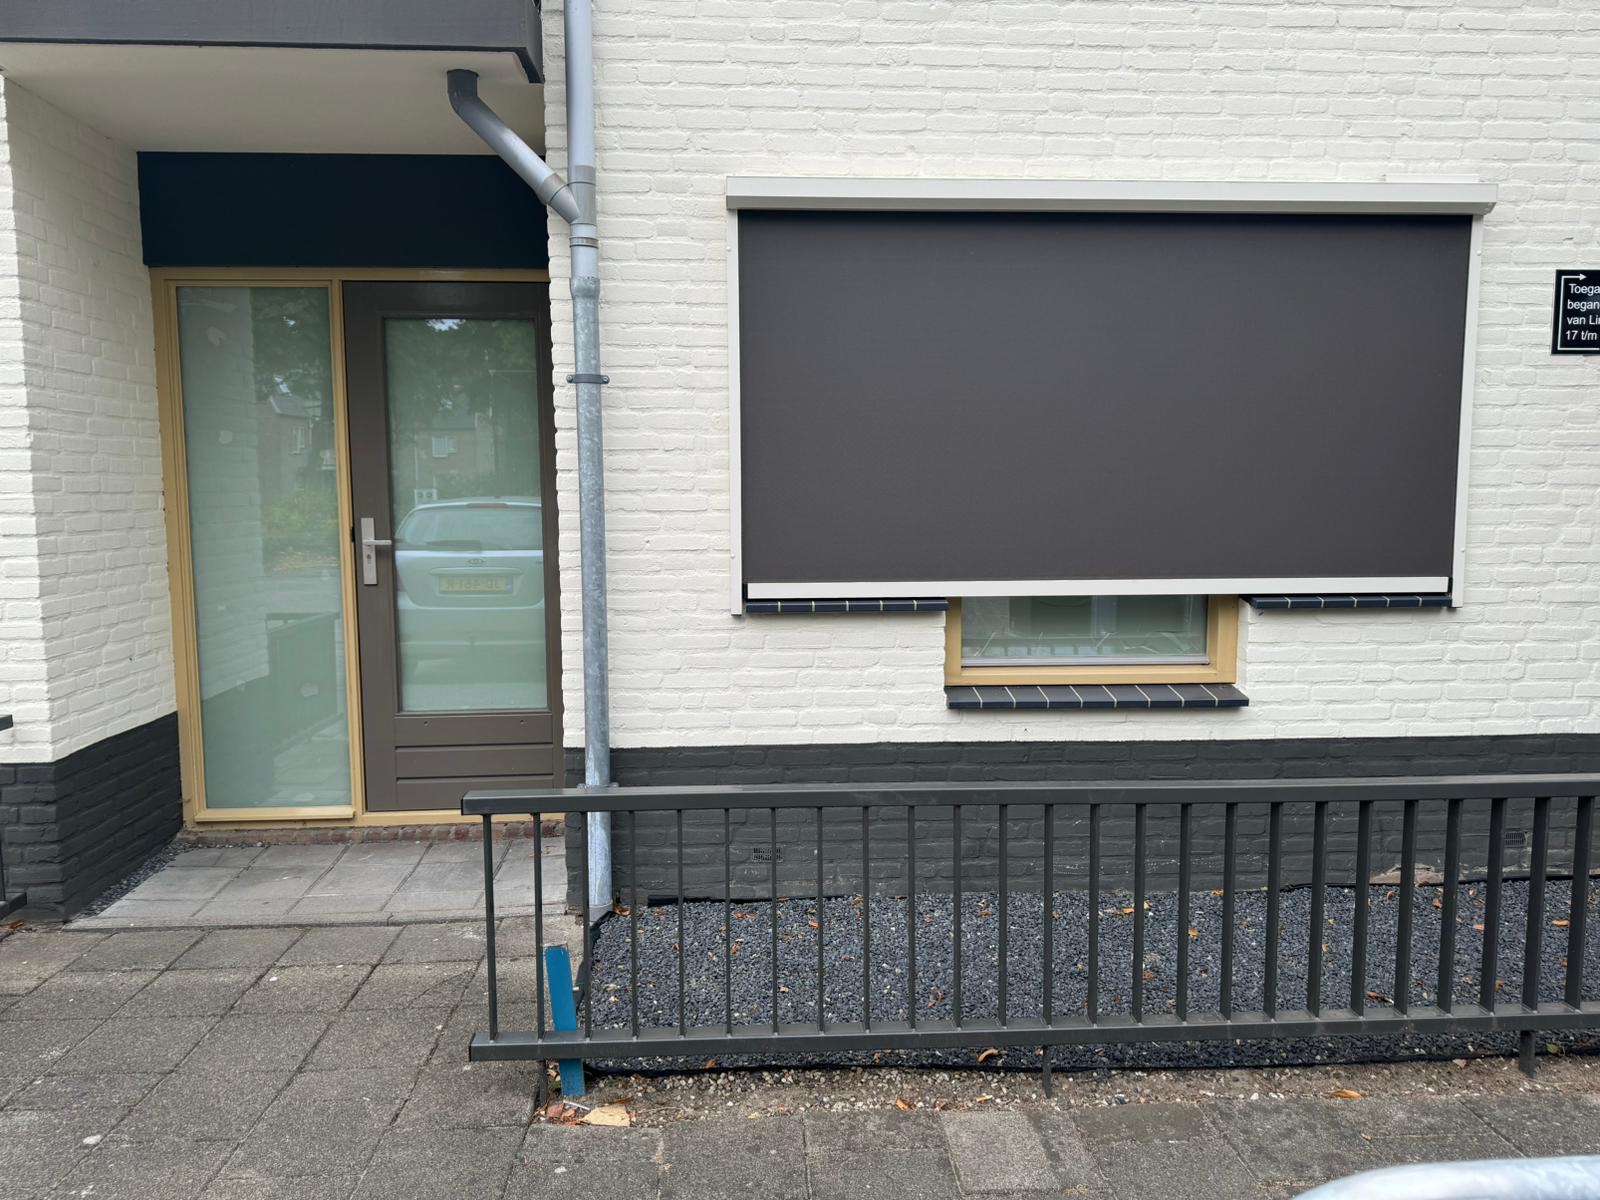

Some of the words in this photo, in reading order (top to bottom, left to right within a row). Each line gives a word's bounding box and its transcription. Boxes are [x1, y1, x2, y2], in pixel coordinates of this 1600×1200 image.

[1566, 316, 1586, 325] van
[1589, 315, 1600, 325] Li
[1565, 330, 1578, 341] 17
[1581, 330, 1598, 341] t/m
